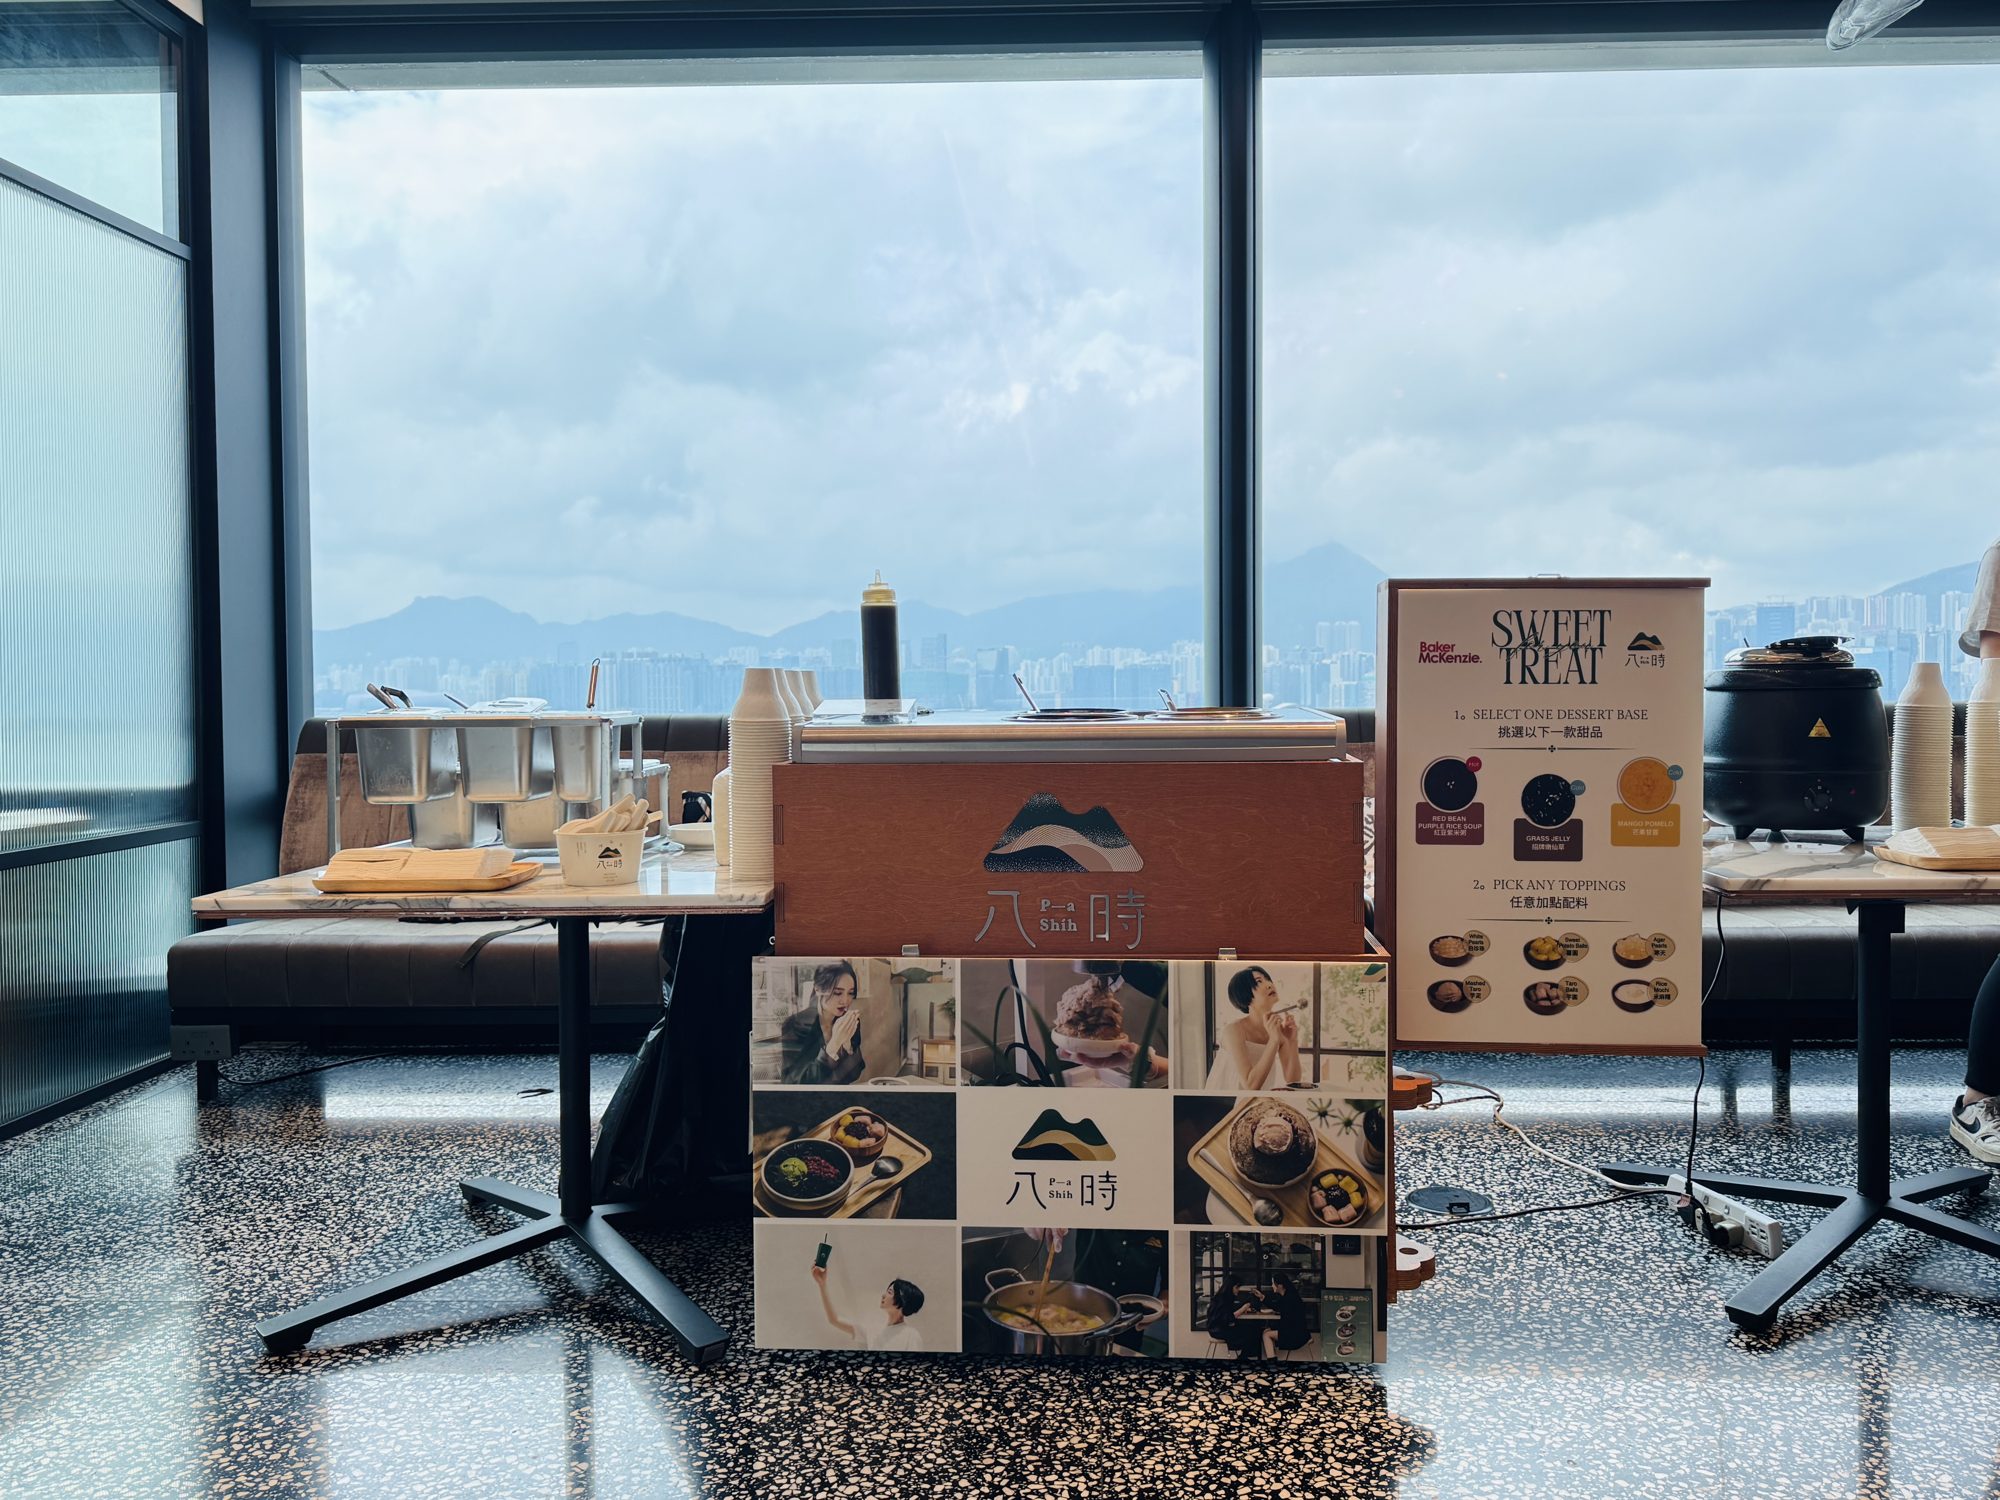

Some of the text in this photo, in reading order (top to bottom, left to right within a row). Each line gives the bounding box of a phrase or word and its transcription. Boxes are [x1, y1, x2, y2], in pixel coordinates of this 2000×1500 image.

[1491, 610, 1612, 648] SWEET
[1420, 641, 1456, 652] Baker
[1418, 652, 1482, 664] McKenzie.
[1624, 654, 1640, 668] 八
[1651, 653, 1666, 668] 時
[1499, 647, 1604, 685] TREAT
[1473, 709, 1521, 720] SELECT
[1524, 709, 1553, 720] ONE
[1557, 709, 1614, 720] DESSERT
[1617, 709, 1648, 720] BASE
[1498, 726, 1603, 738] 挑選以下一款甜品
[1493, 879, 1524, 891] PICK
[1525, 880, 1555, 891] ANY
[1559, 880, 1626, 891] TOPPINGS
[1510, 896, 1589, 910] 任意加點配料
[974, 888, 1145, 950] 八 時
[1039, 918, 1078, 932] Shih
[1006, 1170, 1118, 1211] 八 時
[1048, 1190, 1073, 1199] Shih
